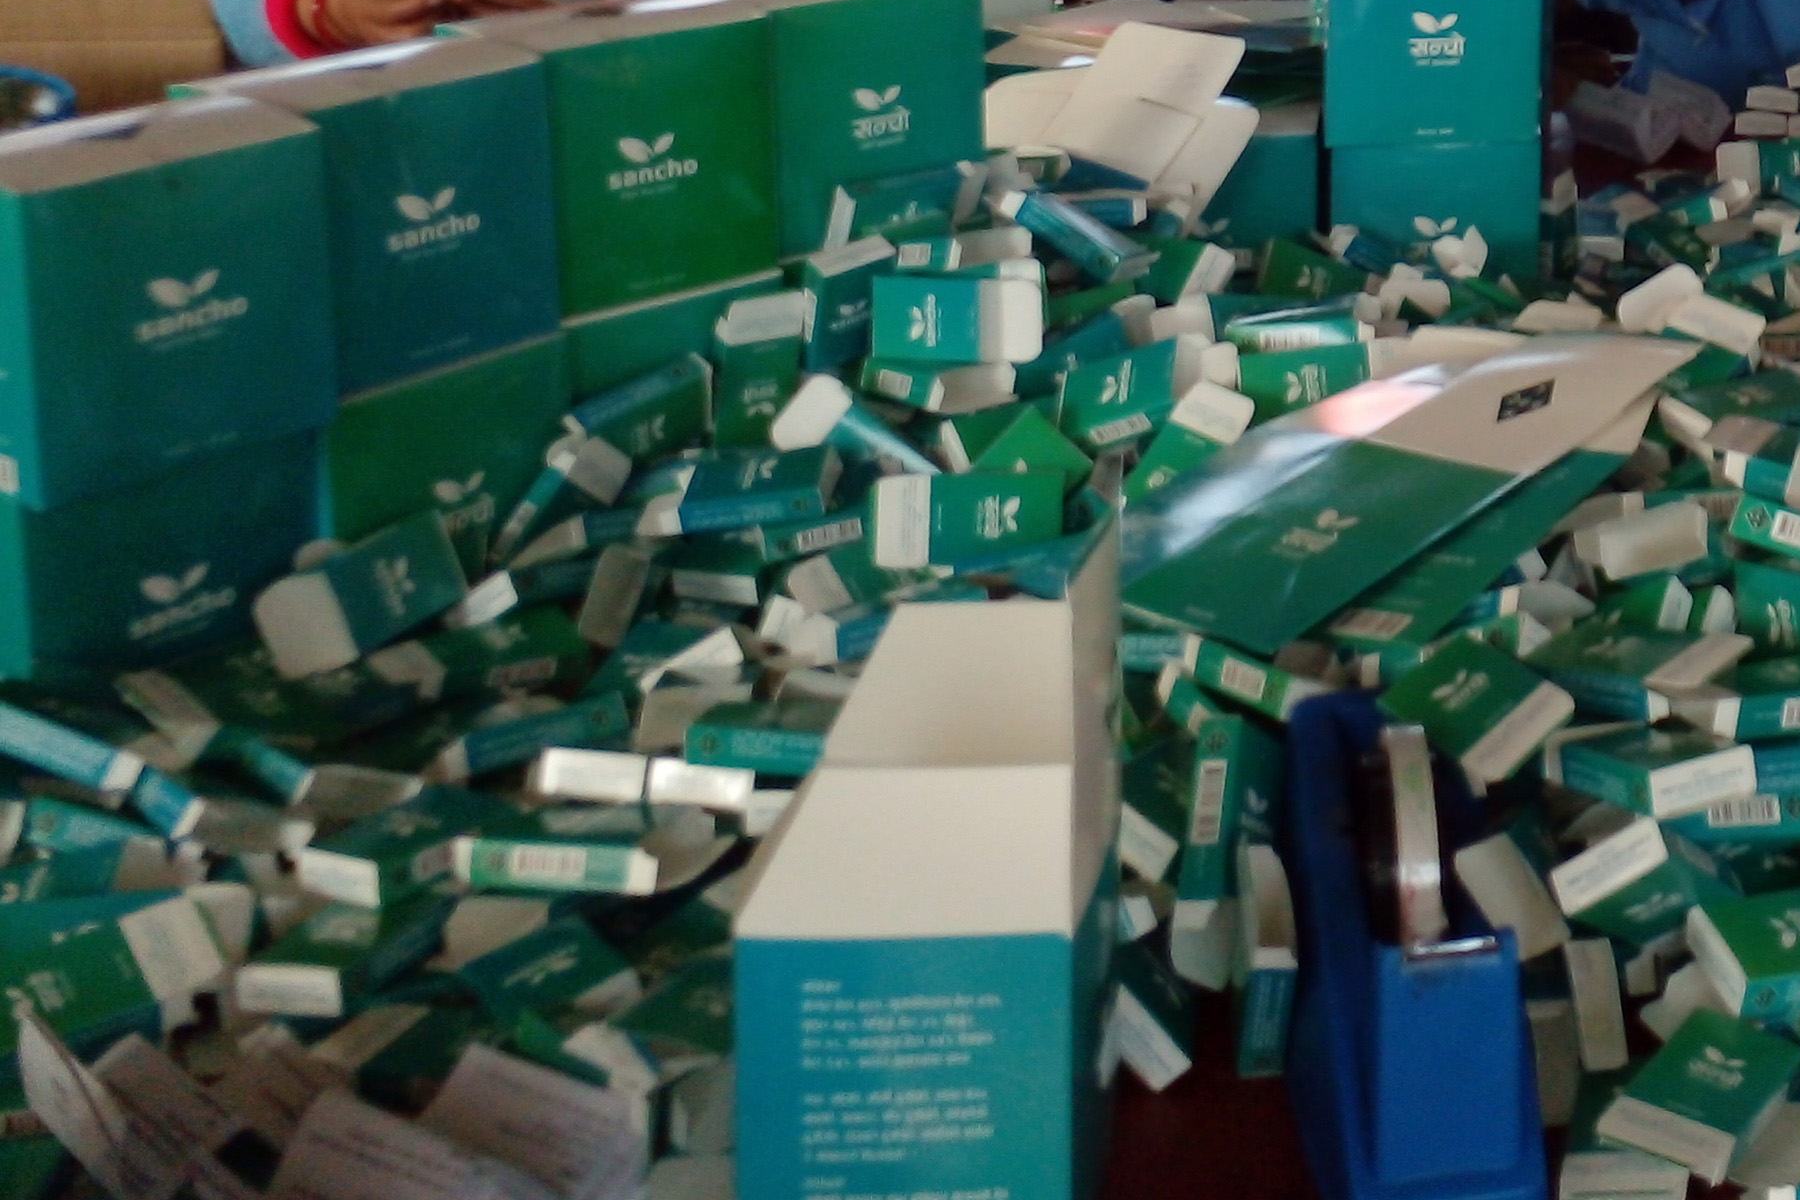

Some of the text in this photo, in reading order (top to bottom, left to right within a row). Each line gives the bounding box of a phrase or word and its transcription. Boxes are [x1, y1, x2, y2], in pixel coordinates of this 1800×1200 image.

[608, 158, 699, 191] sancho
[386, 213, 481, 253] sancho
[132, 297, 248, 343] sancho
